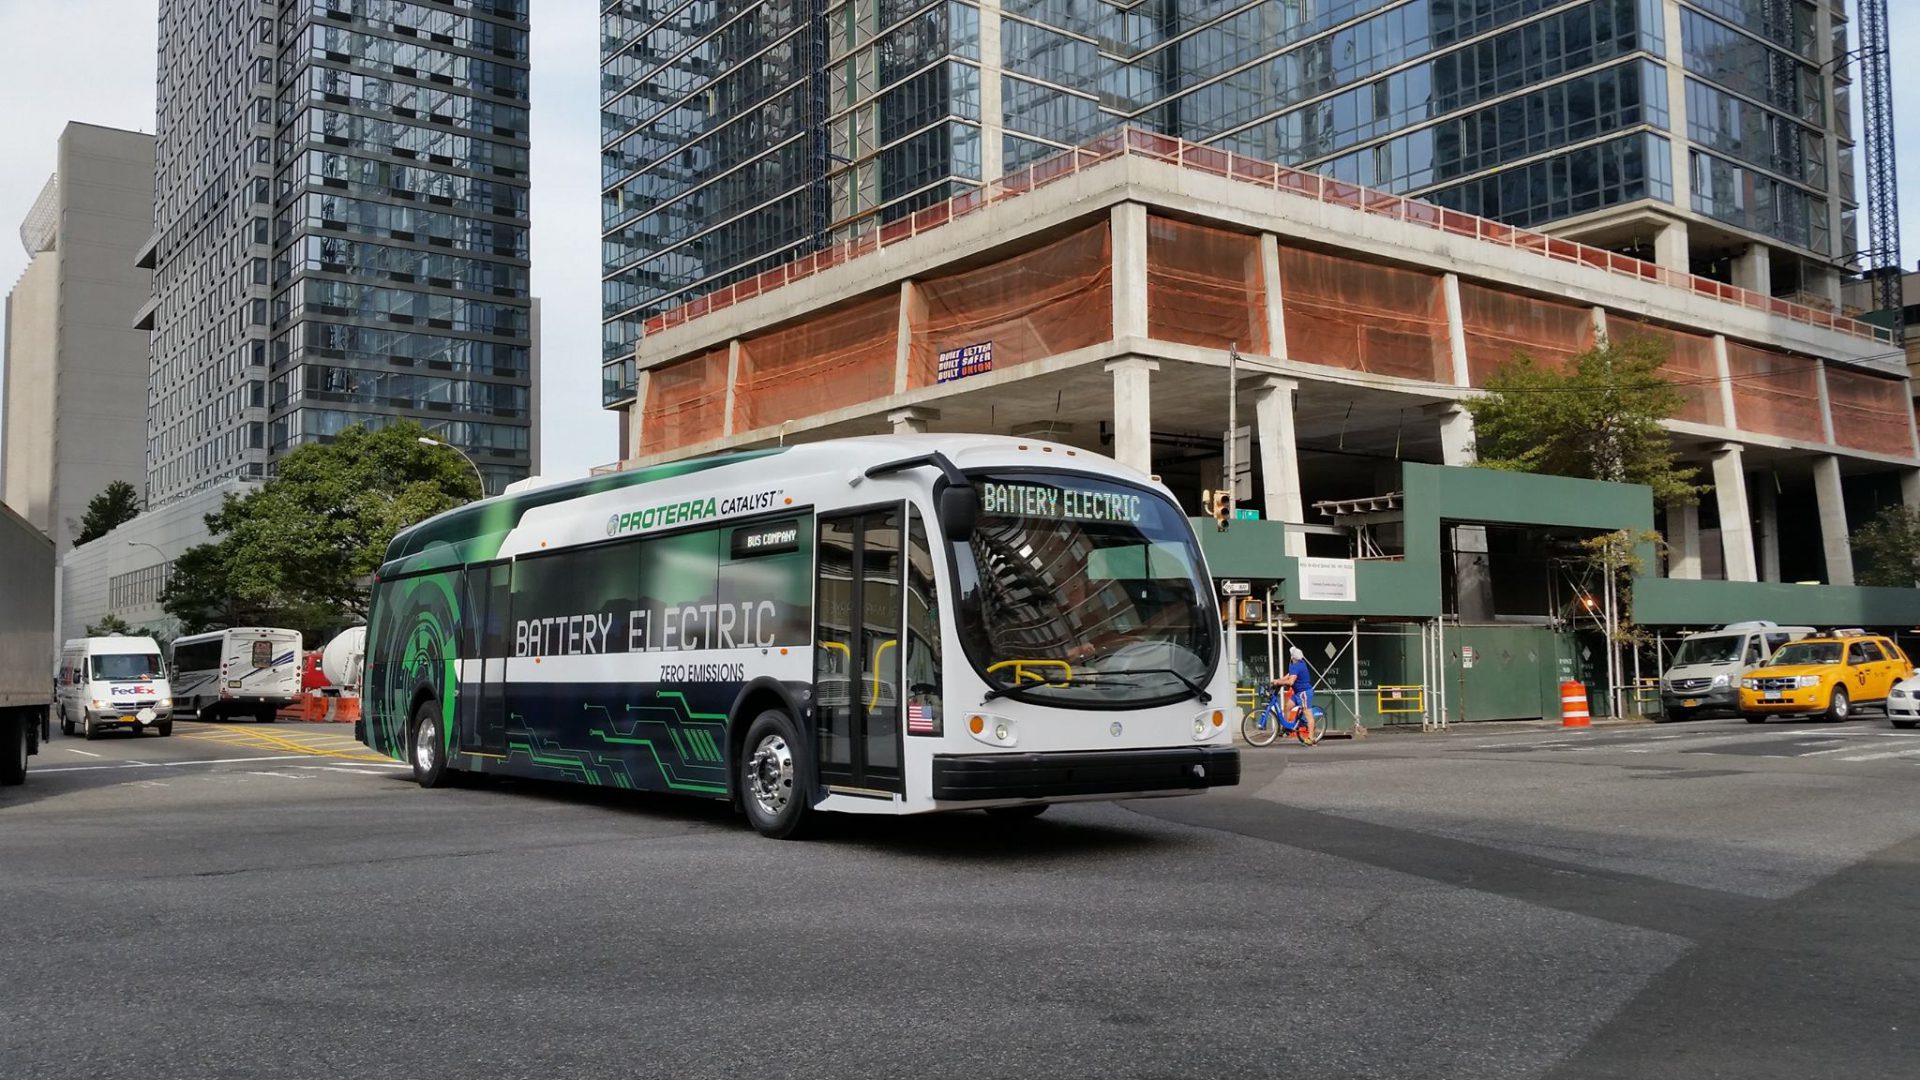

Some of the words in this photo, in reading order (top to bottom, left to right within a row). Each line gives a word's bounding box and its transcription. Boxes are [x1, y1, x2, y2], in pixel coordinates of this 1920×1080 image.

[938, 359, 960, 371] BUILT
[962, 352, 991, 366] SAFER
[939, 350, 961, 362] BUILT
[938, 368, 960, 380] BUILT
[962, 361, 991, 376] UNION
[984, 483, 1058, 516] BATTERY
[1063, 489, 1141, 521] ELECTRIC
[618, 496, 717, 534] PROTERRA
[720, 490, 776, 515] CATALYST
[747, 534, 762, 548] BUS
[762, 529, 797, 545] COMPANY
[515, 612, 613, 658] BATTERY
[628, 600, 776, 652] ELECTRIC
[660, 665, 686, 683] ZERO
[688, 663, 745, 683] EMISSIONS
[111, 686, 156, 695] FedEx
